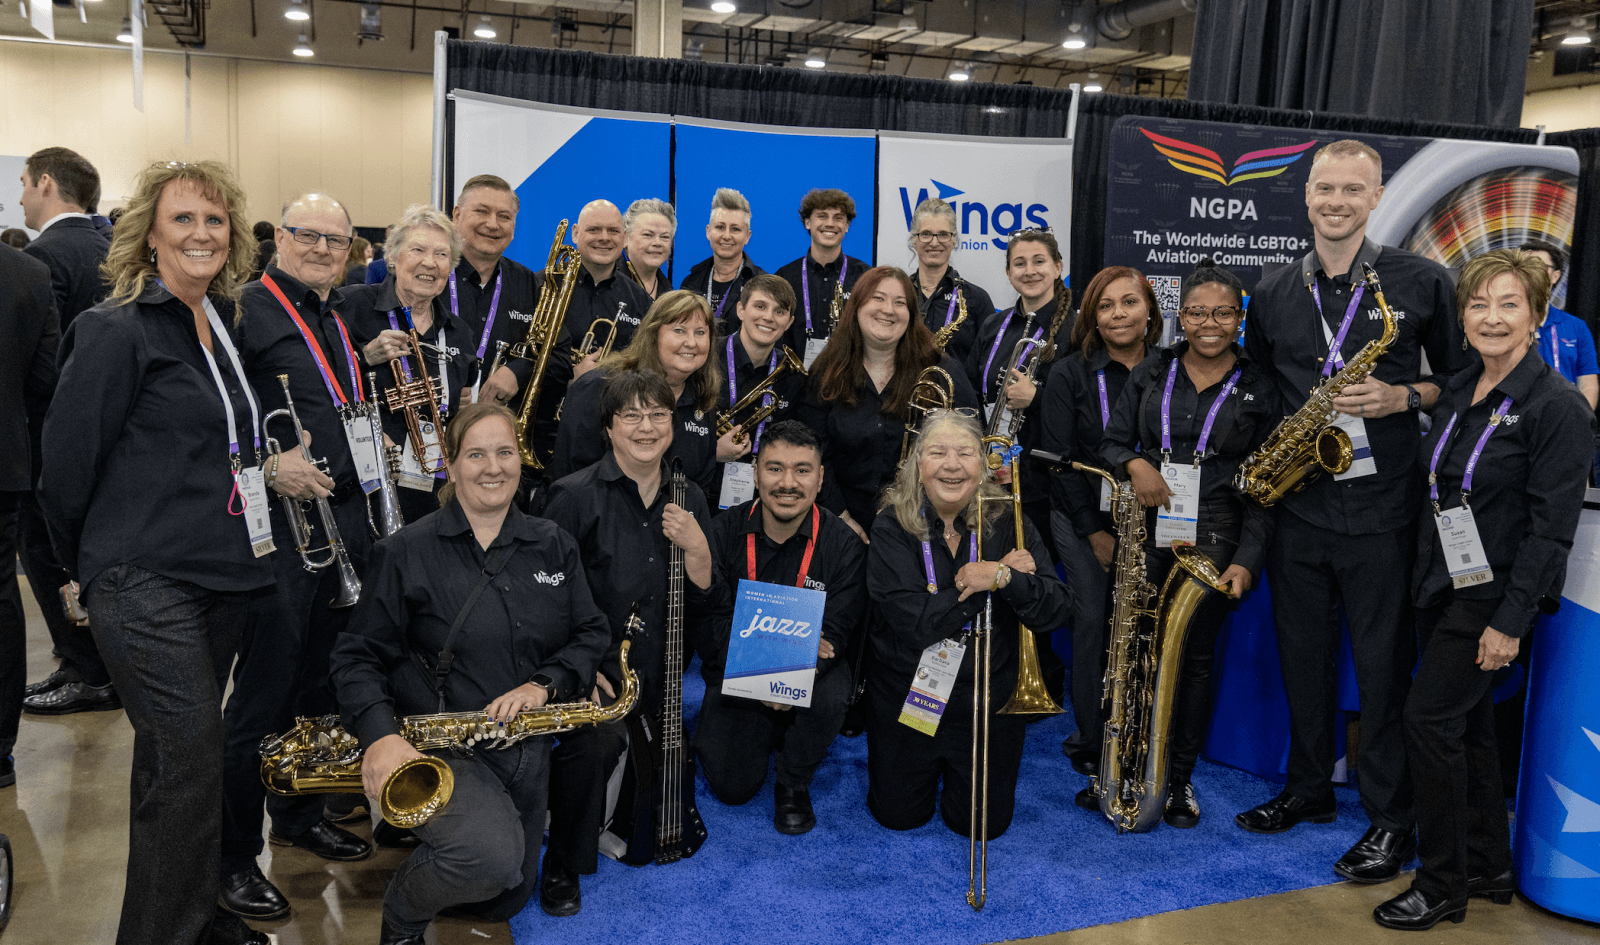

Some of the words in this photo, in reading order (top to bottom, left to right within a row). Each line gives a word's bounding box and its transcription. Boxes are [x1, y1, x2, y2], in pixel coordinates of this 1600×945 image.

[1190, 197, 1258, 221] NGPA
[1133, 230, 1161, 245] The
[1166, 232, 1246, 248] Worldwide
[1250, 235, 1309, 250] LGBTQ+
[1146, 249, 1208, 264] Aviation
[1212, 251, 1294, 266] Community
[508, 309, 533, 323] Wings
[618, 311, 641, 325] Wings
[1367, 307, 1405, 322] Wigs
[1492, 408, 1520, 426] ngs
[684, 420, 709, 437] Wings
[1450, 529, 1466, 537] Susan
[255, 541, 272, 554] SILVER
[533, 570, 565, 587] Wings
[804, 575, 826, 591] ings
[1458, 573, 1487, 585] SILVER
[740, 608, 812, 638] jazz
[931, 655, 950, 666] Barbara
[769, 681, 807, 700] Wings
[920, 698, 940, 711] YEARS
